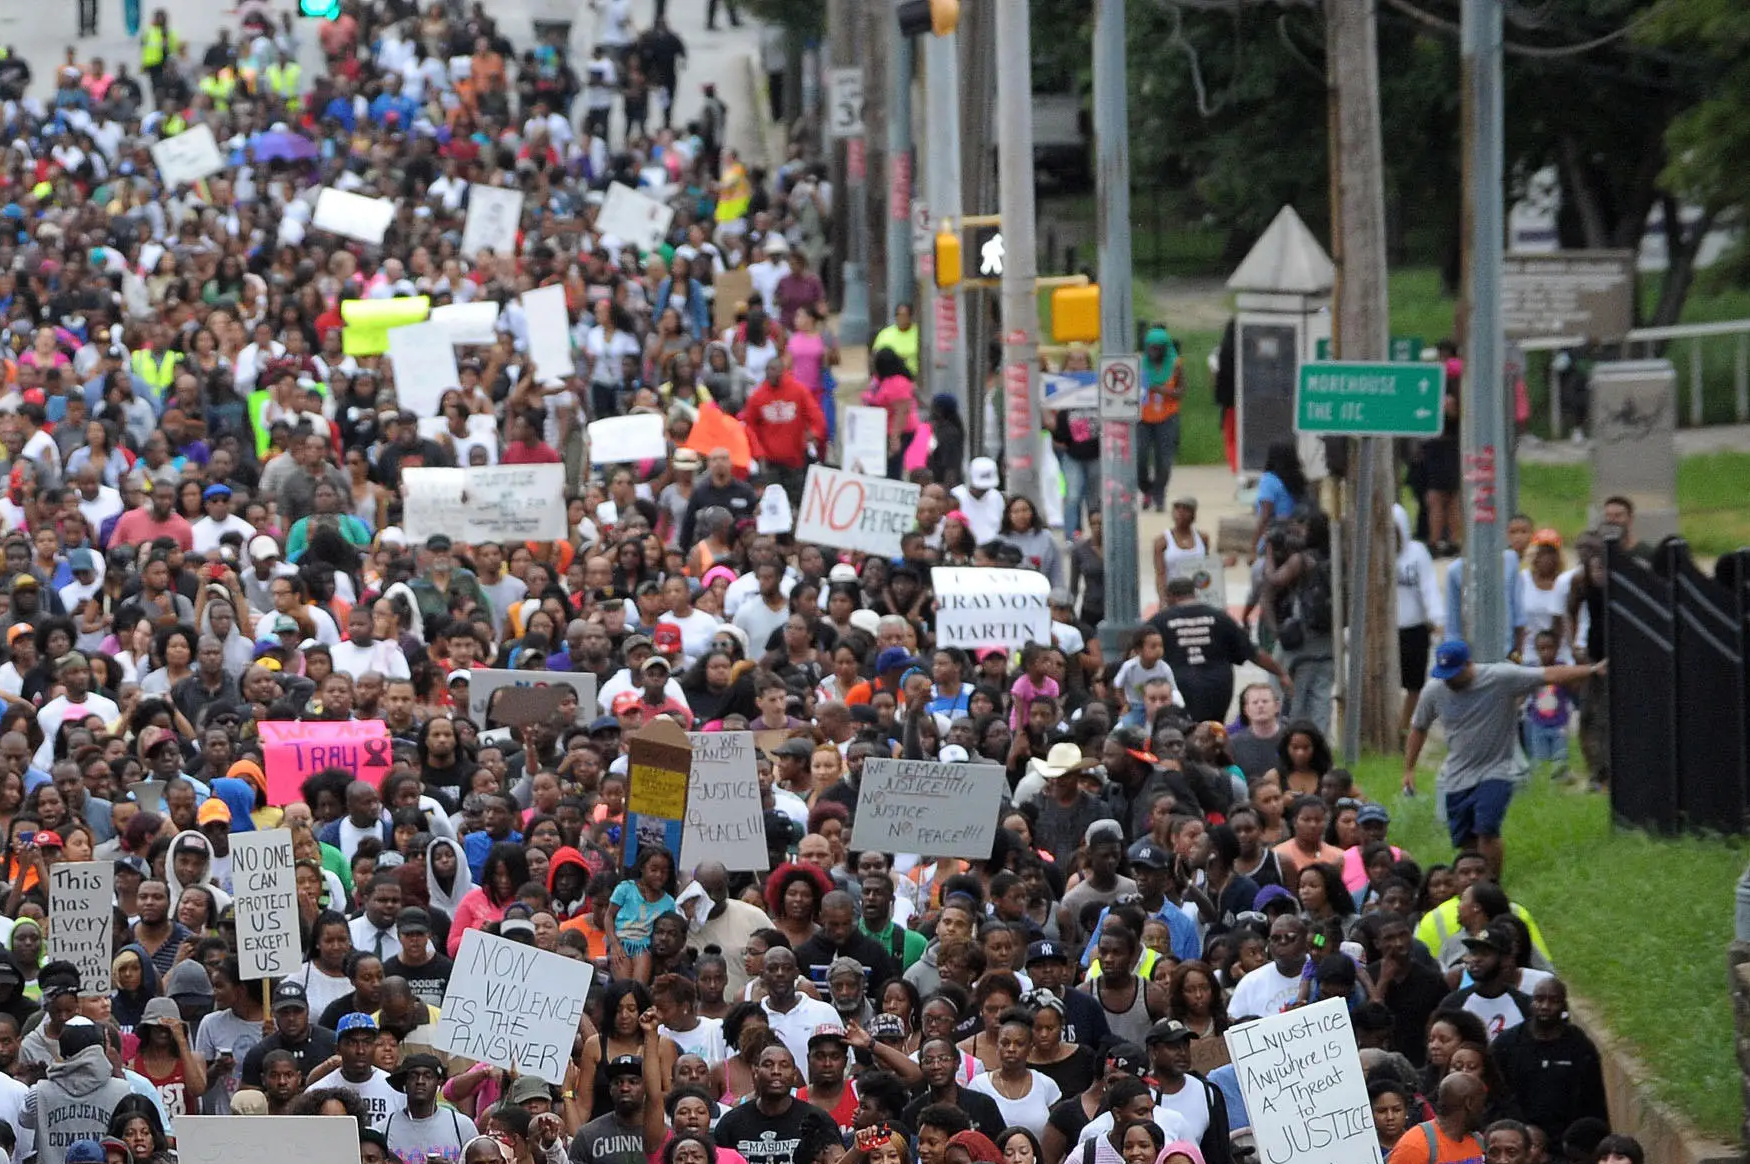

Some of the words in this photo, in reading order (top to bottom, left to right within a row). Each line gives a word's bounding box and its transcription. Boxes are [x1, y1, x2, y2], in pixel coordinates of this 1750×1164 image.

[1306, 375, 1397, 395] MOREHOUSE
[1306, 402, 1333, 421] THE
[804, 473, 866, 531] NO
[860, 507, 913, 533] PEACE
[939, 593, 1049, 609] TRAYVON
[945, 622, 1035, 641] MARTIN
[866, 760, 890, 775] WE
[894, 762, 968, 780] DEMAND
[698, 780, 758, 801] JUSTICE
[862, 791, 885, 807] NO
[871, 805, 930, 819] JUSTICE
[888, 821, 914, 838] NO
[232, 847, 258, 872] NO
[263, 843, 294, 870] ONE
[53, 869, 102, 890] This
[249, 872, 277, 891] CAN
[52, 896, 89, 912] has
[238, 893, 292, 914] PROTECT
[51, 915, 109, 945] Every
[251, 911, 281, 932] US
[244, 932, 290, 951] EXCEPT
[255, 951, 280, 972] US
[470, 938, 538, 982] NON
[486, 980, 582, 1026] VIOLENCE
[442, 995, 477, 1025] IS
[485, 1009, 529, 1037] THE
[450, 1024, 558, 1078] ANSWER
[48, 1107, 81, 1127] POLO
[82, 1105, 111, 1124] JEANS
[1263, 1097, 1276, 1114] A
[1297, 1103, 1316, 1120] to
[1267, 1104, 1375, 1164] JUSTICE
[749, 1139, 791, 1152] MASON
